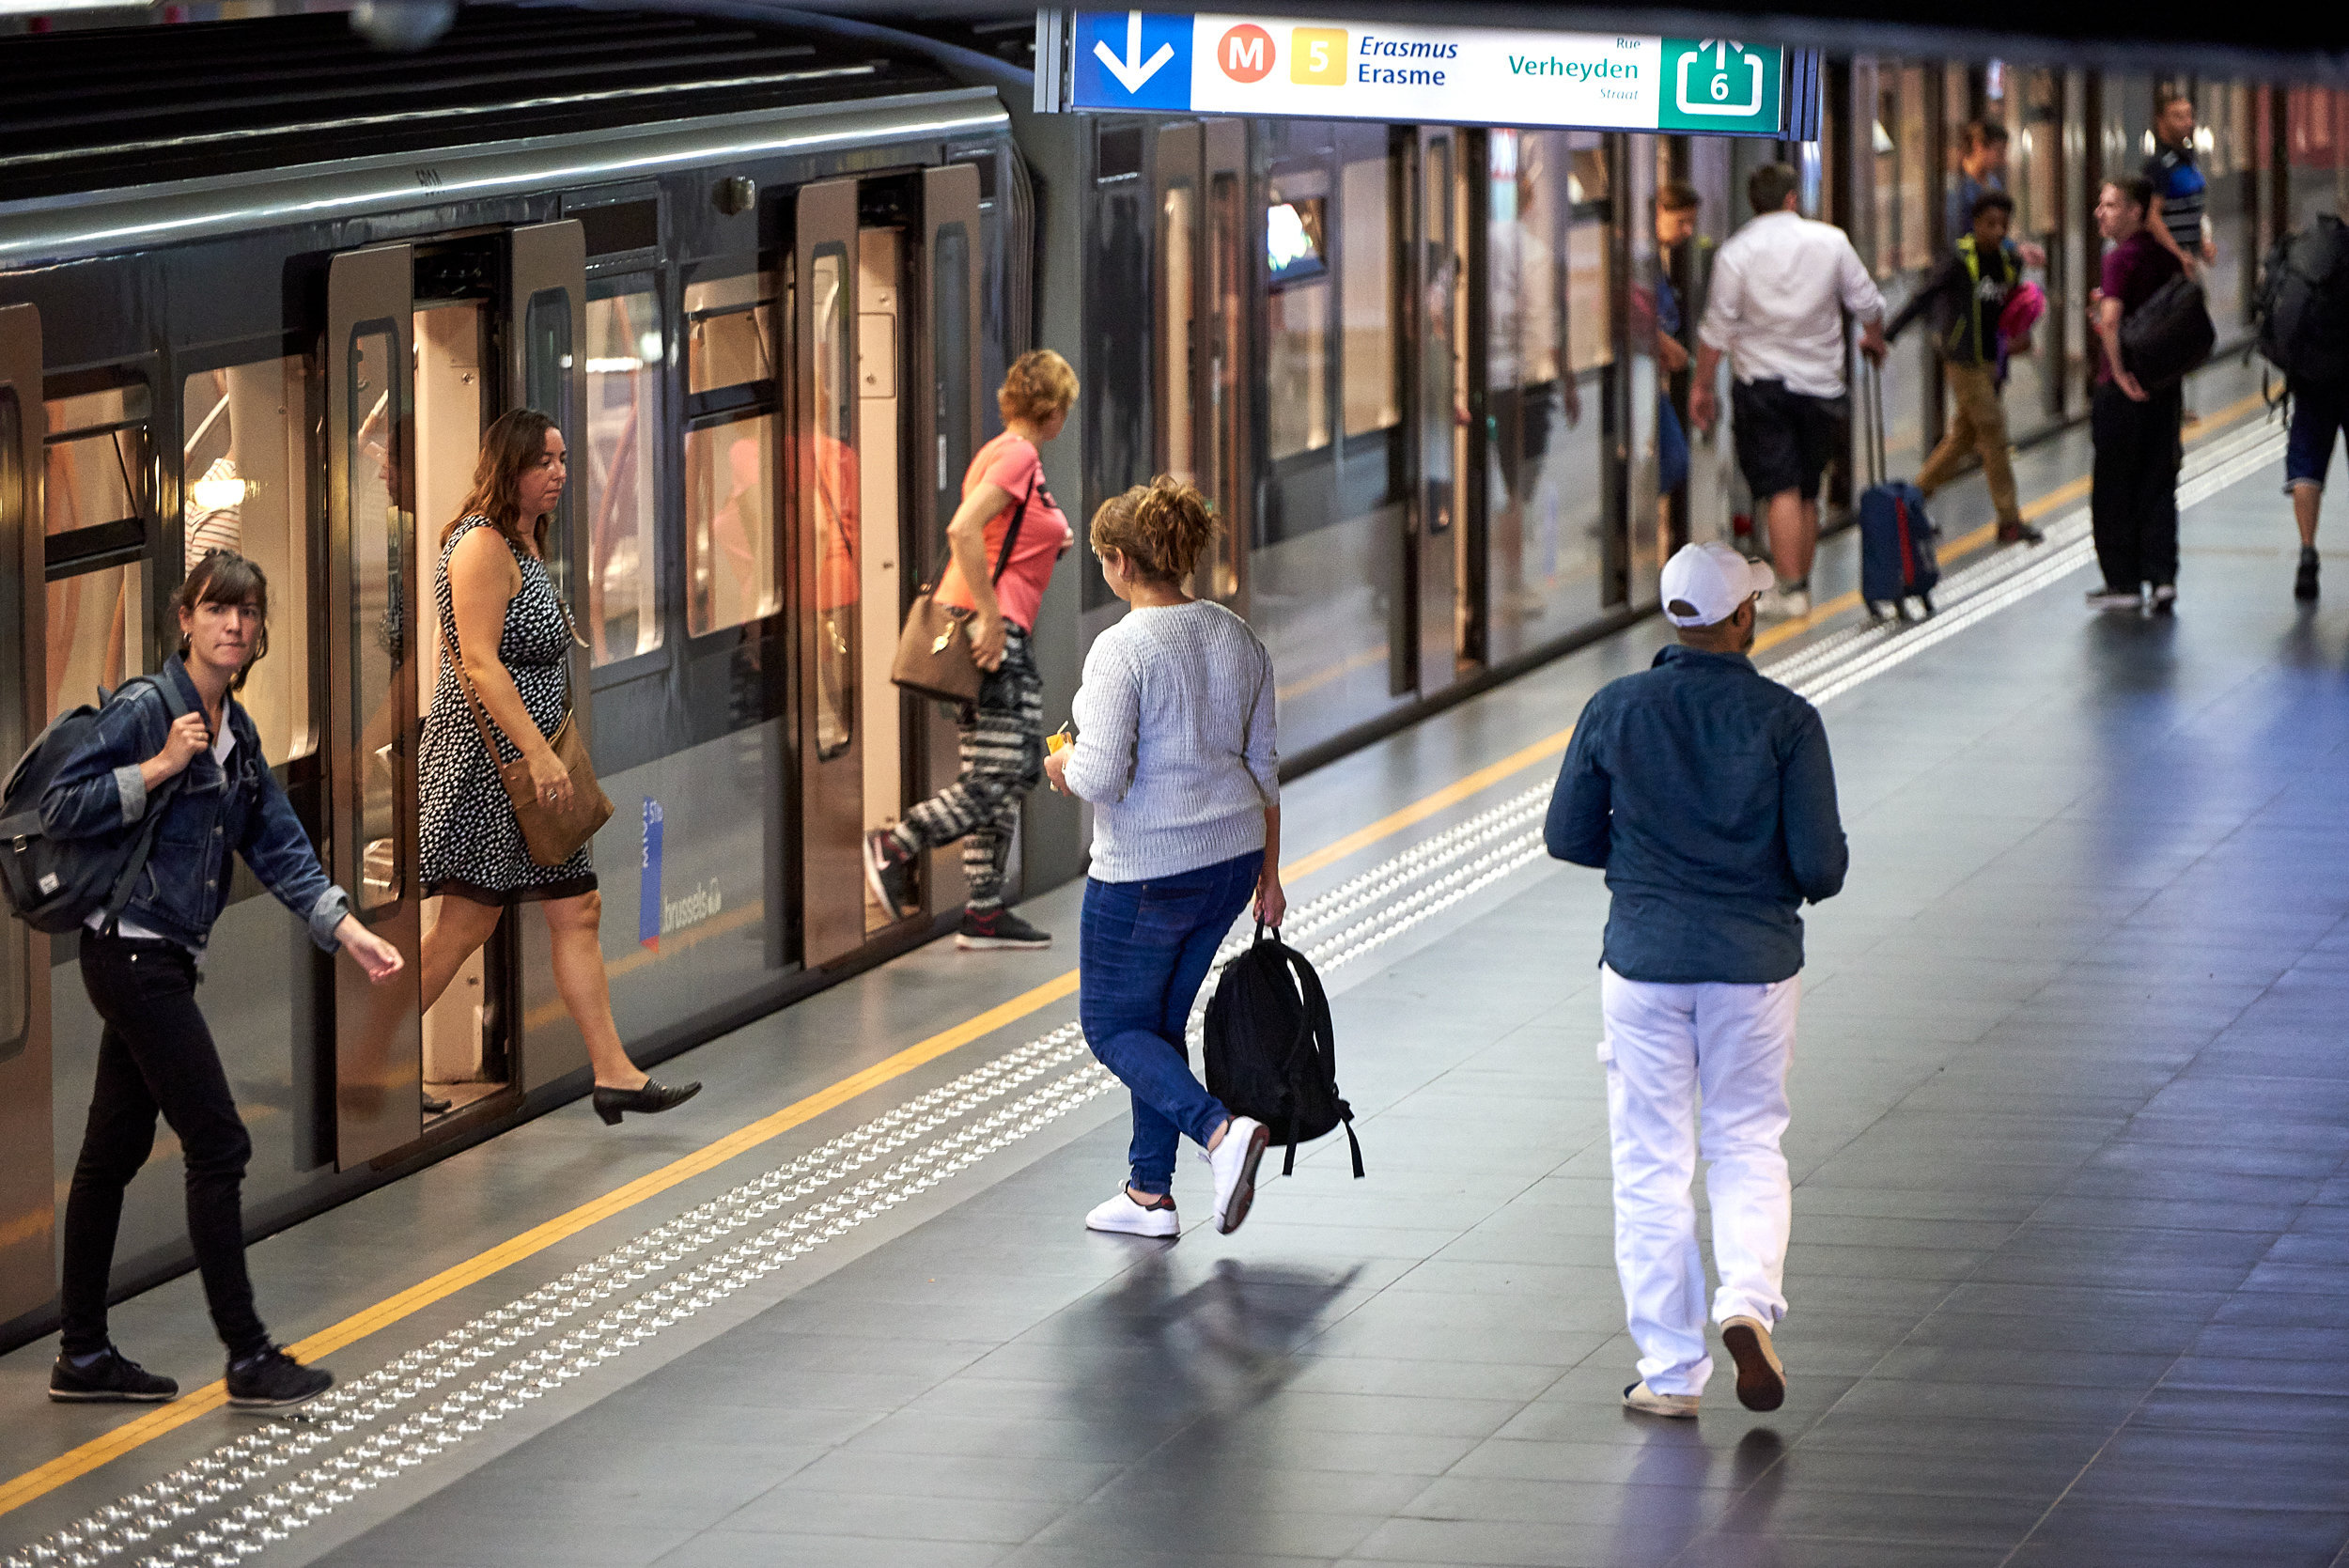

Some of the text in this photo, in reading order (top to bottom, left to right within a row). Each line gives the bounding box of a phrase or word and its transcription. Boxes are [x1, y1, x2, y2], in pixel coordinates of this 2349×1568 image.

[1229, 36, 1330, 73] M 5
[1360, 36, 1458, 59] Erasmus
[1616, 37, 1641, 50] Rue
[1359, 63, 1446, 86] Erasme
[1509, 54, 1639, 83] Verheyden
[1600, 87, 1639, 101] Straat
[1710, 72, 1730, 101] 6
